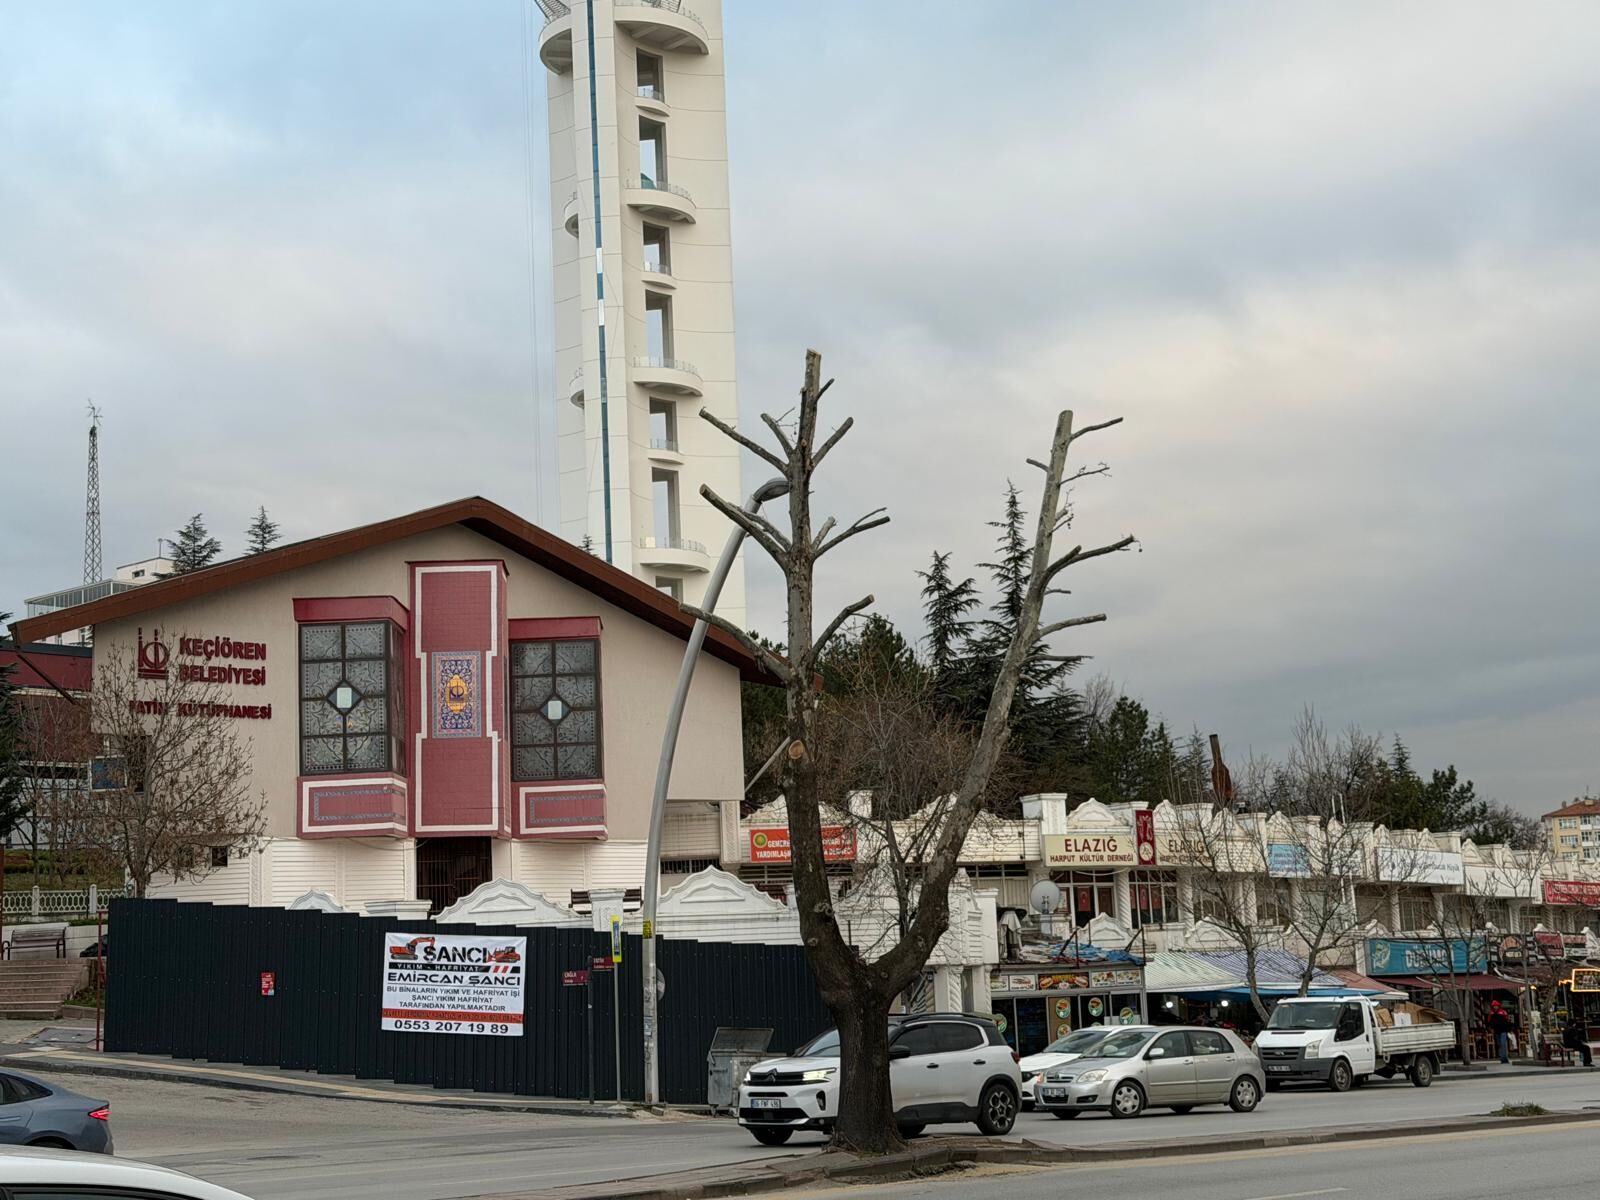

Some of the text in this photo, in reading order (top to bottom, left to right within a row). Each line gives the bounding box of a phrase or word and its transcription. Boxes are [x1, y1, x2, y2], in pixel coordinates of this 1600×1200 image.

[179, 636, 267, 661] KEÇİÖREN
[179, 664, 266, 686] BELEDİYESİ
[177, 700, 272, 720] KÜTÜPHANESİ
[1064, 836, 1118, 853] ELAZIĞ
[1050, 854, 1134, 863] HARPUT KÜLTÜR DERNEĞİ
[388, 971, 520, 987] EMİRCAN ŞANCI
[399, 986, 438, 994] BİNALARIN
[473, 989, 509, 997] HAFRİYAT
[400, 1001, 506, 1012] TARAFINDAN YAPILMAKTADIR
[458, 996, 493, 1004] HAFRİYAT
[394, 1019, 509, 1034] 0553 207 19 89
